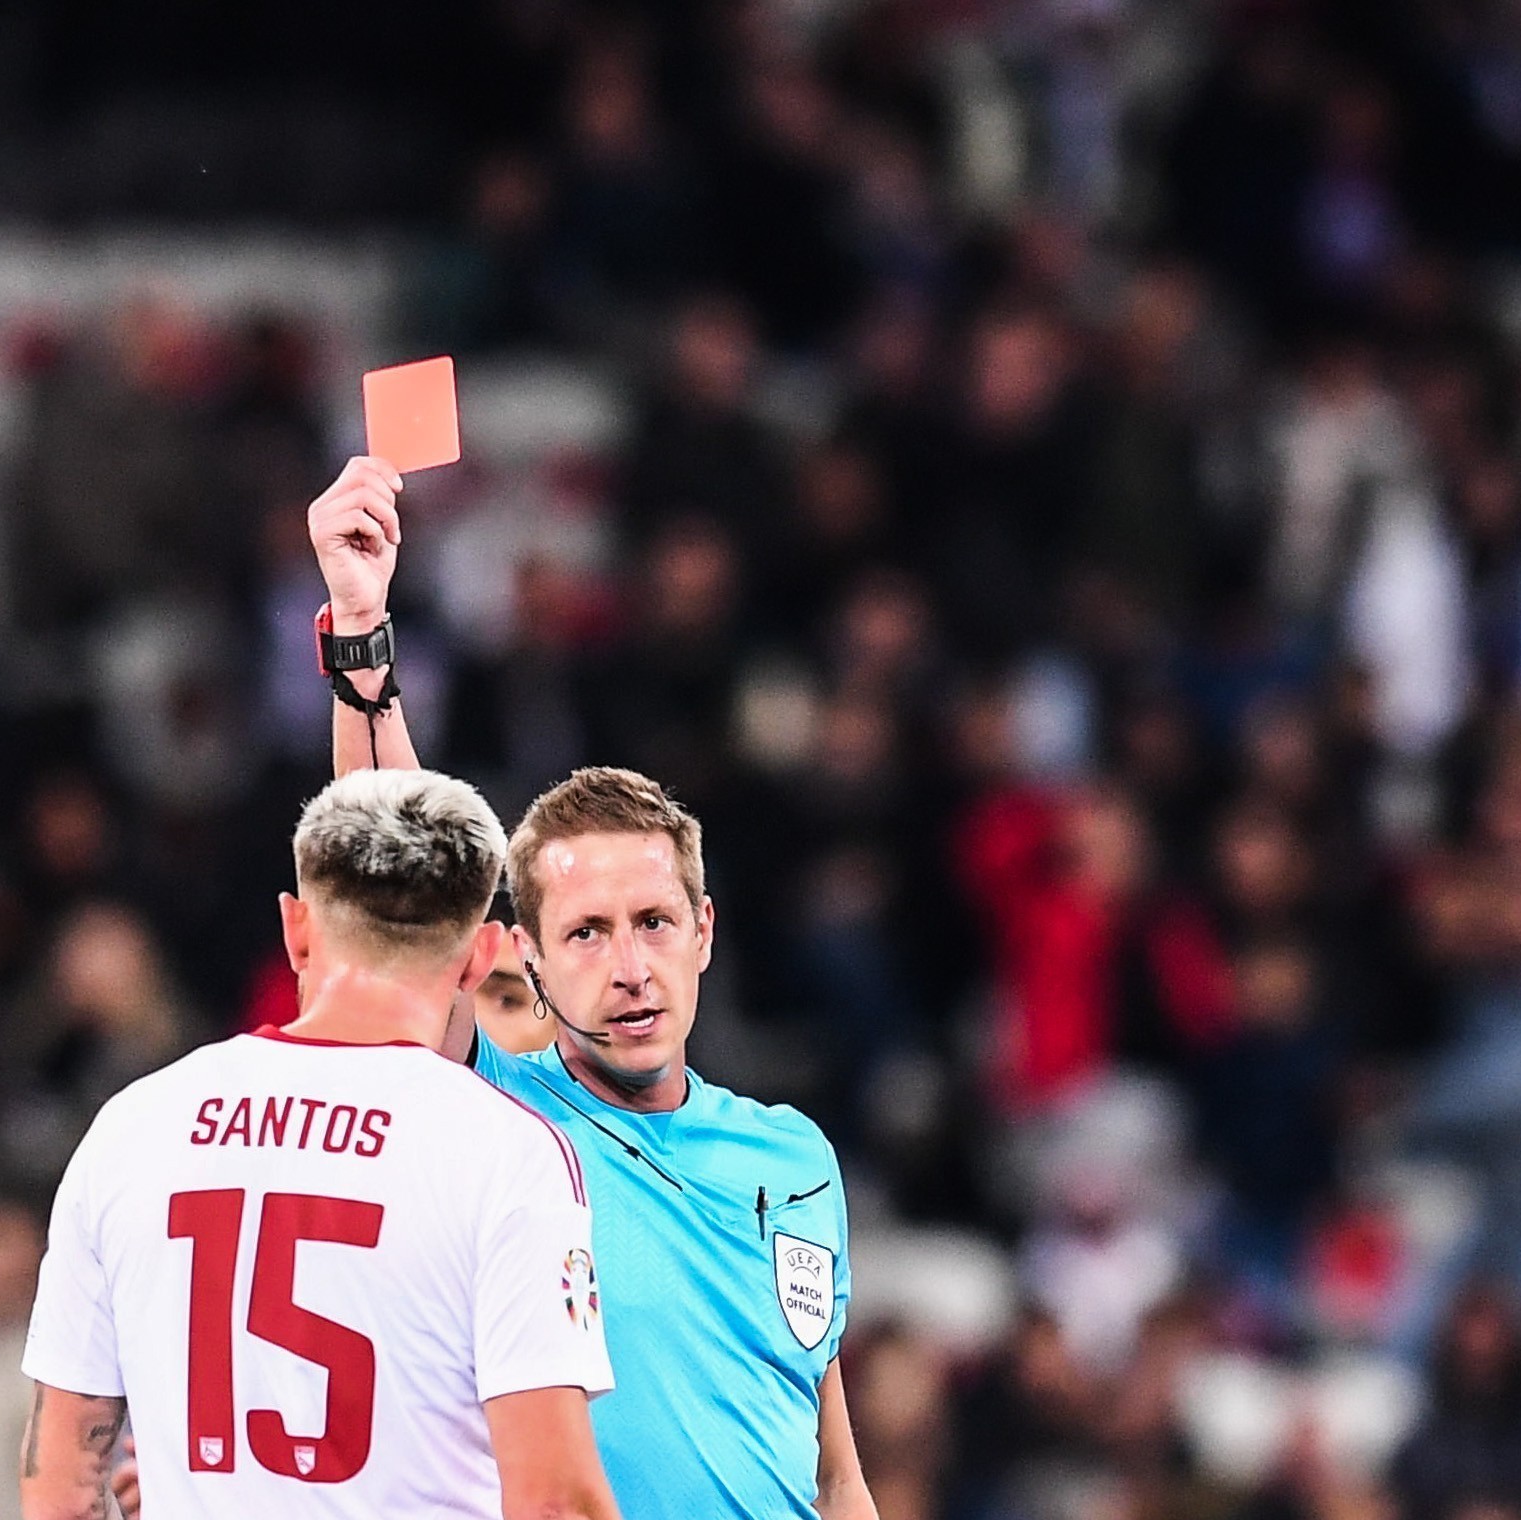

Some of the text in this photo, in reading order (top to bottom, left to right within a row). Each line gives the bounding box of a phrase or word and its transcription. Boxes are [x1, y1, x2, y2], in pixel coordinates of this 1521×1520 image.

[191, 1096, 391, 1158] SANTOS
[787, 1252, 821, 1277] UEFA
[790, 1282, 822, 1302] MATCH
[786, 1297, 826, 1320] OFFICIAL
[168, 1188, 384, 1483] 15
